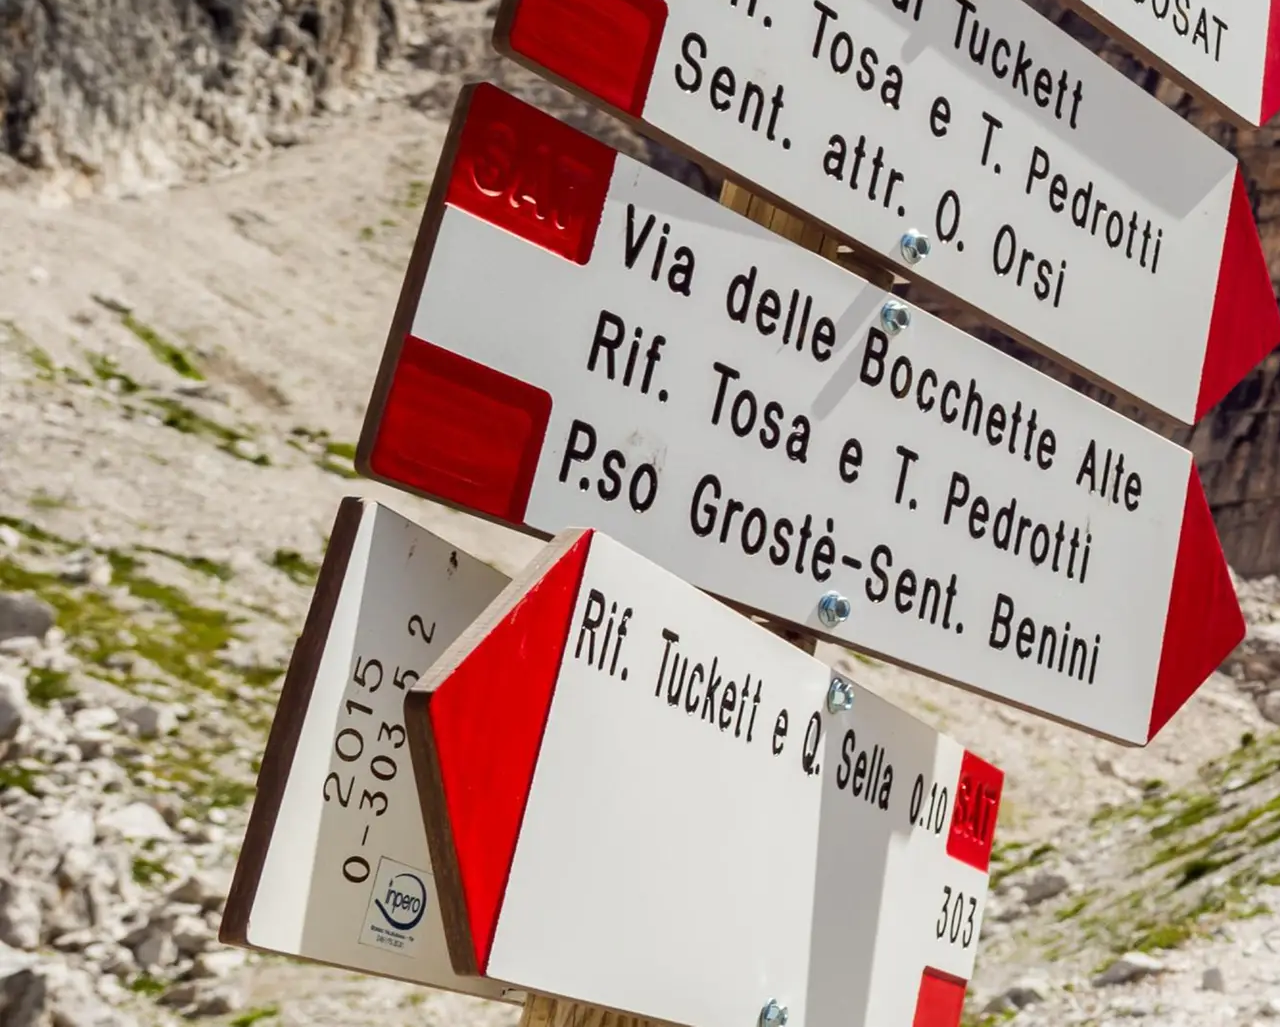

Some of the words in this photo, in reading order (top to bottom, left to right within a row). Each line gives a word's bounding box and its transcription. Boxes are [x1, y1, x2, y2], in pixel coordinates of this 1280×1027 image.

[674, 32, 792, 150] Sent.
[824, 134, 906, 217] attr.
[935, 189, 965, 253] O.
[993, 224, 1067, 308] Orsi
[812, 0, 903, 111] Tosa
[930, 96, 951, 138] e
[982, 111, 1003, 174] T.
[1026, 145, 1163, 274] Pedrotti
[587, 309, 669, 403] Rif.
[711, 361, 811, 464] Tosa
[840, 439, 862, 484] e
[895, 445, 919, 511] T.
[943, 471, 1092, 584] Pedrotti
[624, 203, 695, 297] Via
[726, 265, 836, 363] delle
[860, 326, 1056, 471] Bocchette
[1075, 439, 1143, 512] Alte
[558, 419, 658, 514] P.so
[988, 592, 1101, 685] Benini
[323, 656, 383, 808] 2015
[574, 588, 629, 681] Rif.
[655, 628, 759, 744] Tuckett
[773, 709, 788, 755] e
[802, 711, 821, 776] Q.
[836, 728, 893, 811] Sella
[910, 773, 948, 834] 0.10
[953, 777, 996, 845] SAT
[936, 886, 977, 948] 303
